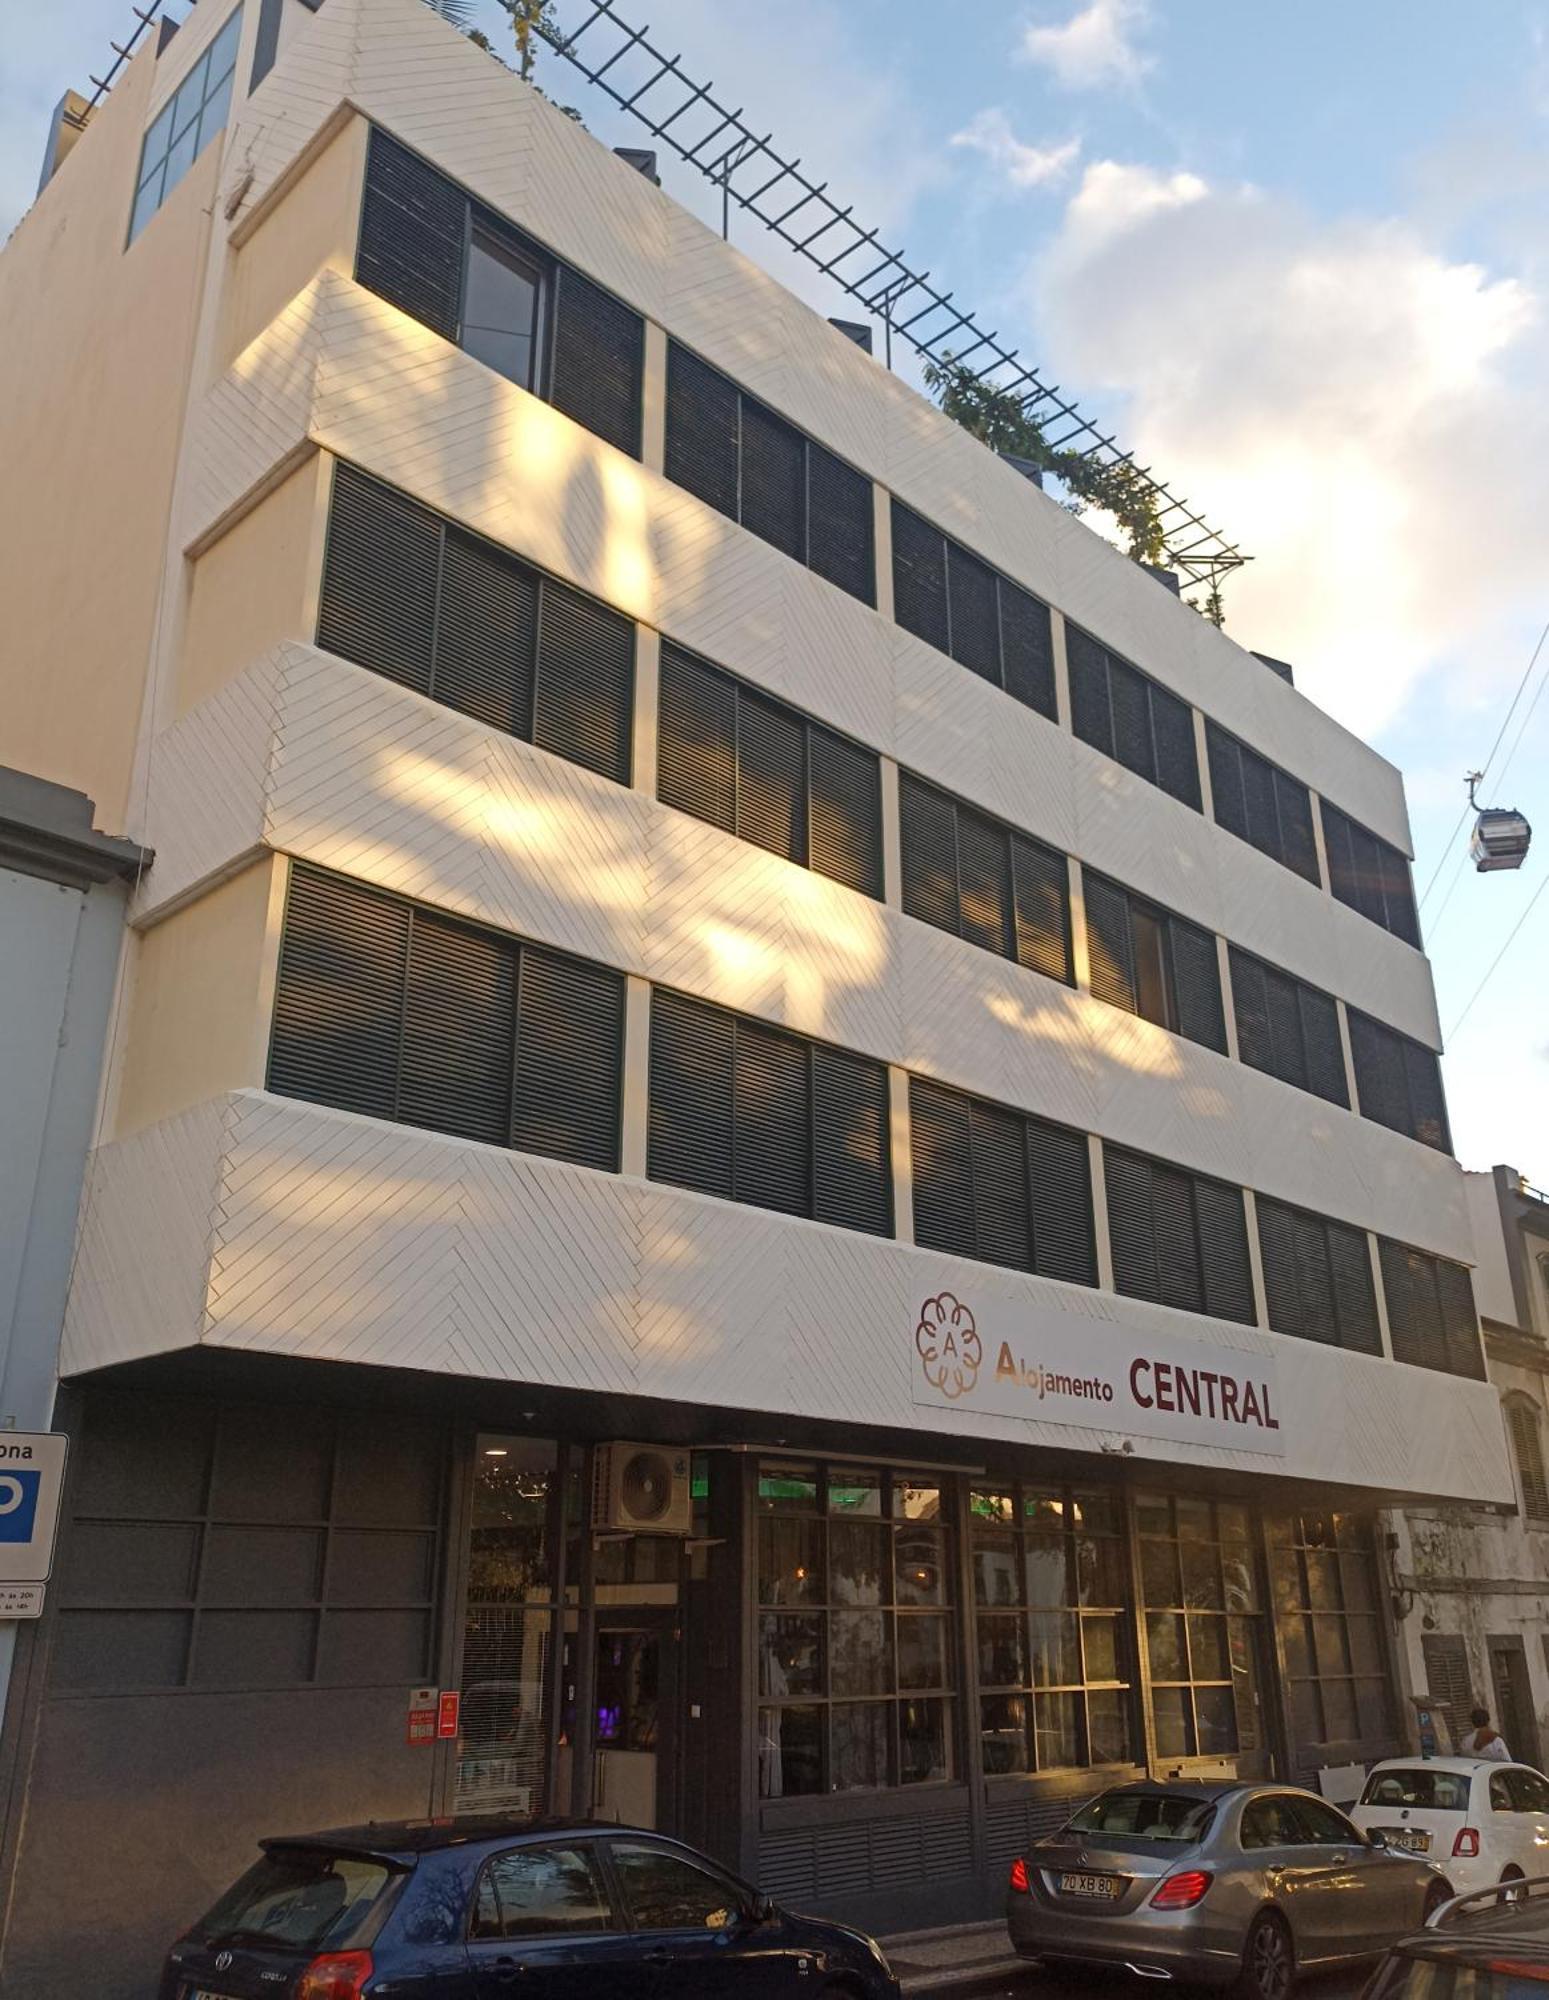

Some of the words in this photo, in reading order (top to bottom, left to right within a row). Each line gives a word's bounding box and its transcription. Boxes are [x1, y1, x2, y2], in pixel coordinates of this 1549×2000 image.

[943, 1331, 958, 1358] A
[994, 1340, 1114, 1402] Alojamento
[1129, 1357, 1280, 1431] CENTRAL
[1063, 1875, 1077, 1889] 70
[1079, 1876, 1096, 1891] XB
[1098, 1878, 1113, 1892] 80
